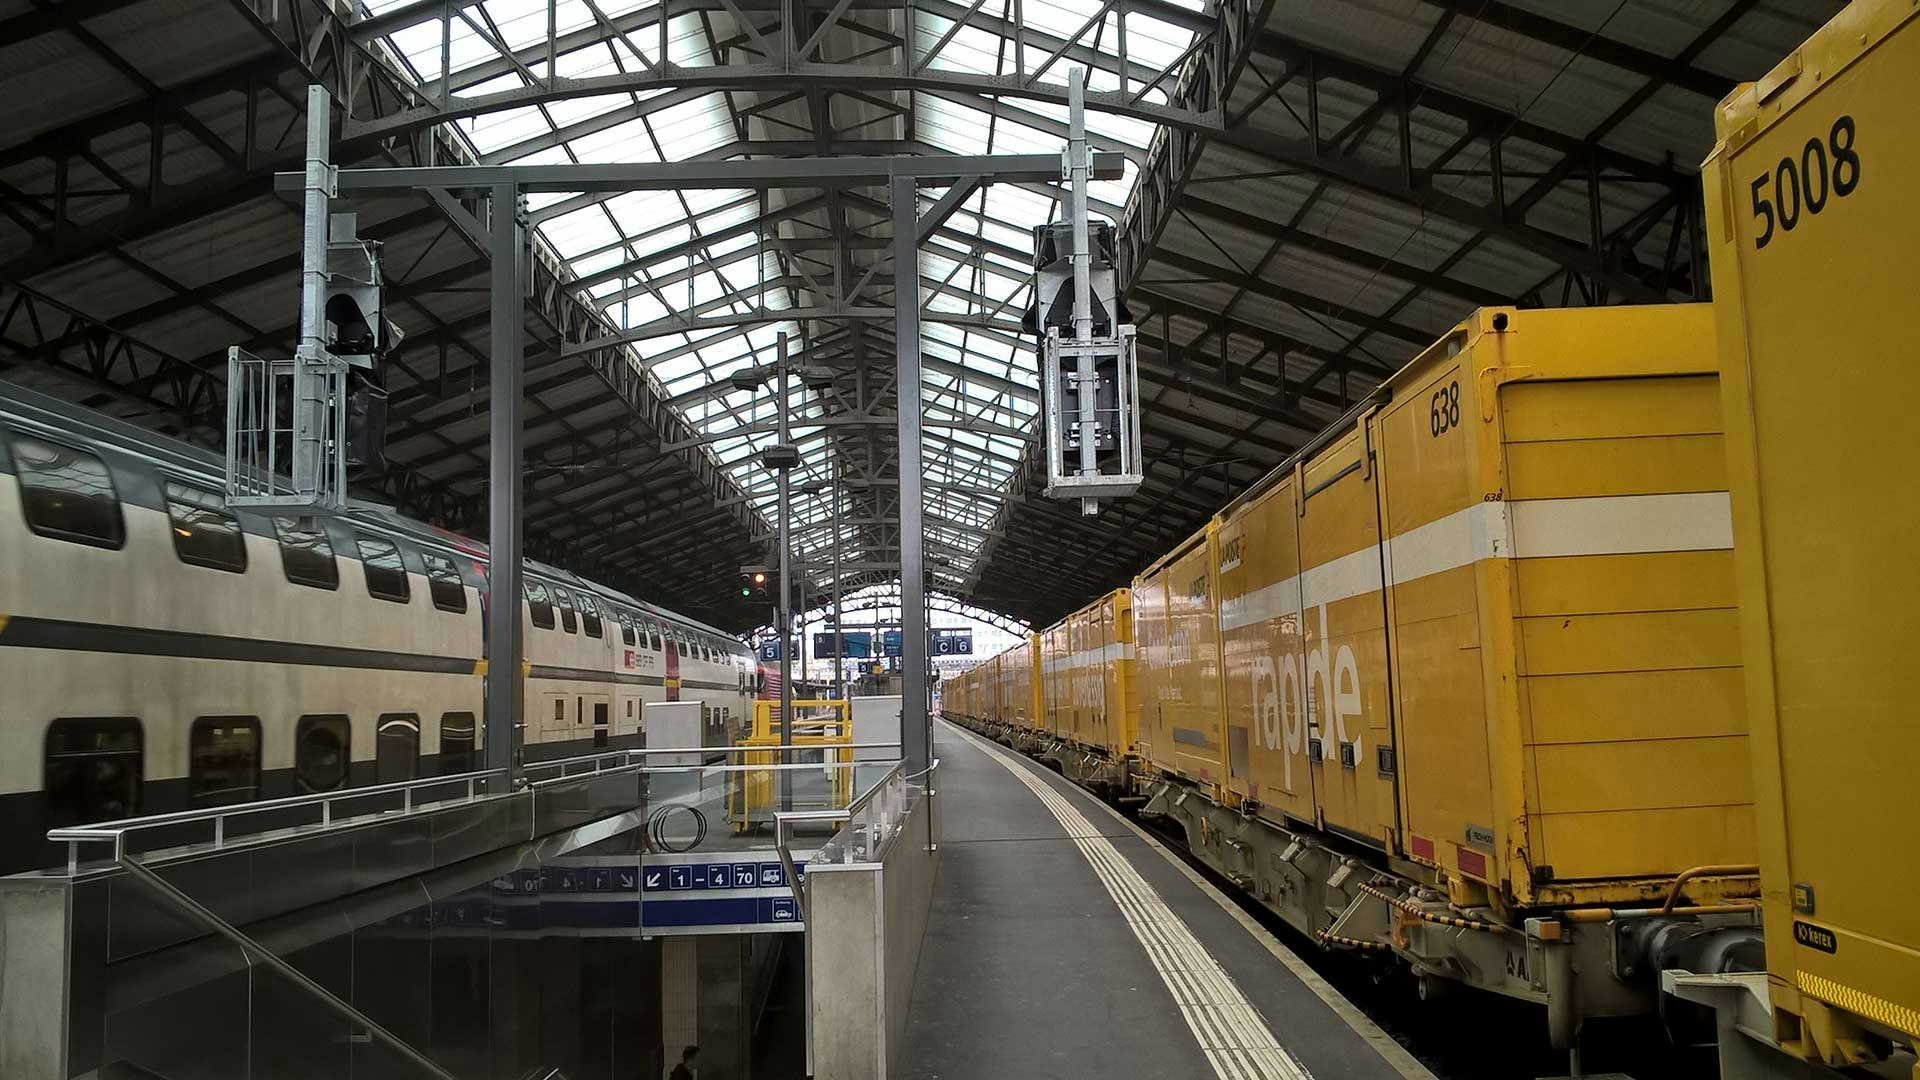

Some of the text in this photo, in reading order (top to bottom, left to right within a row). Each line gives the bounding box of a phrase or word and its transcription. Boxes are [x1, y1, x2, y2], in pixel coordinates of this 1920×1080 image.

[1751, 115, 1861, 250] 5008
[1431, 381, 1460, 438] 638
[1484, 493, 1502, 502] 638
[766, 647, 774, 658] 5
[940, 642, 948, 652] C
[960, 642, 967, 652] 6
[677, 875, 684, 886] 1
[715, 874, 724, 885] 4
[737, 873, 753, 884] 70
[1808, 927, 1832, 949] kerex
